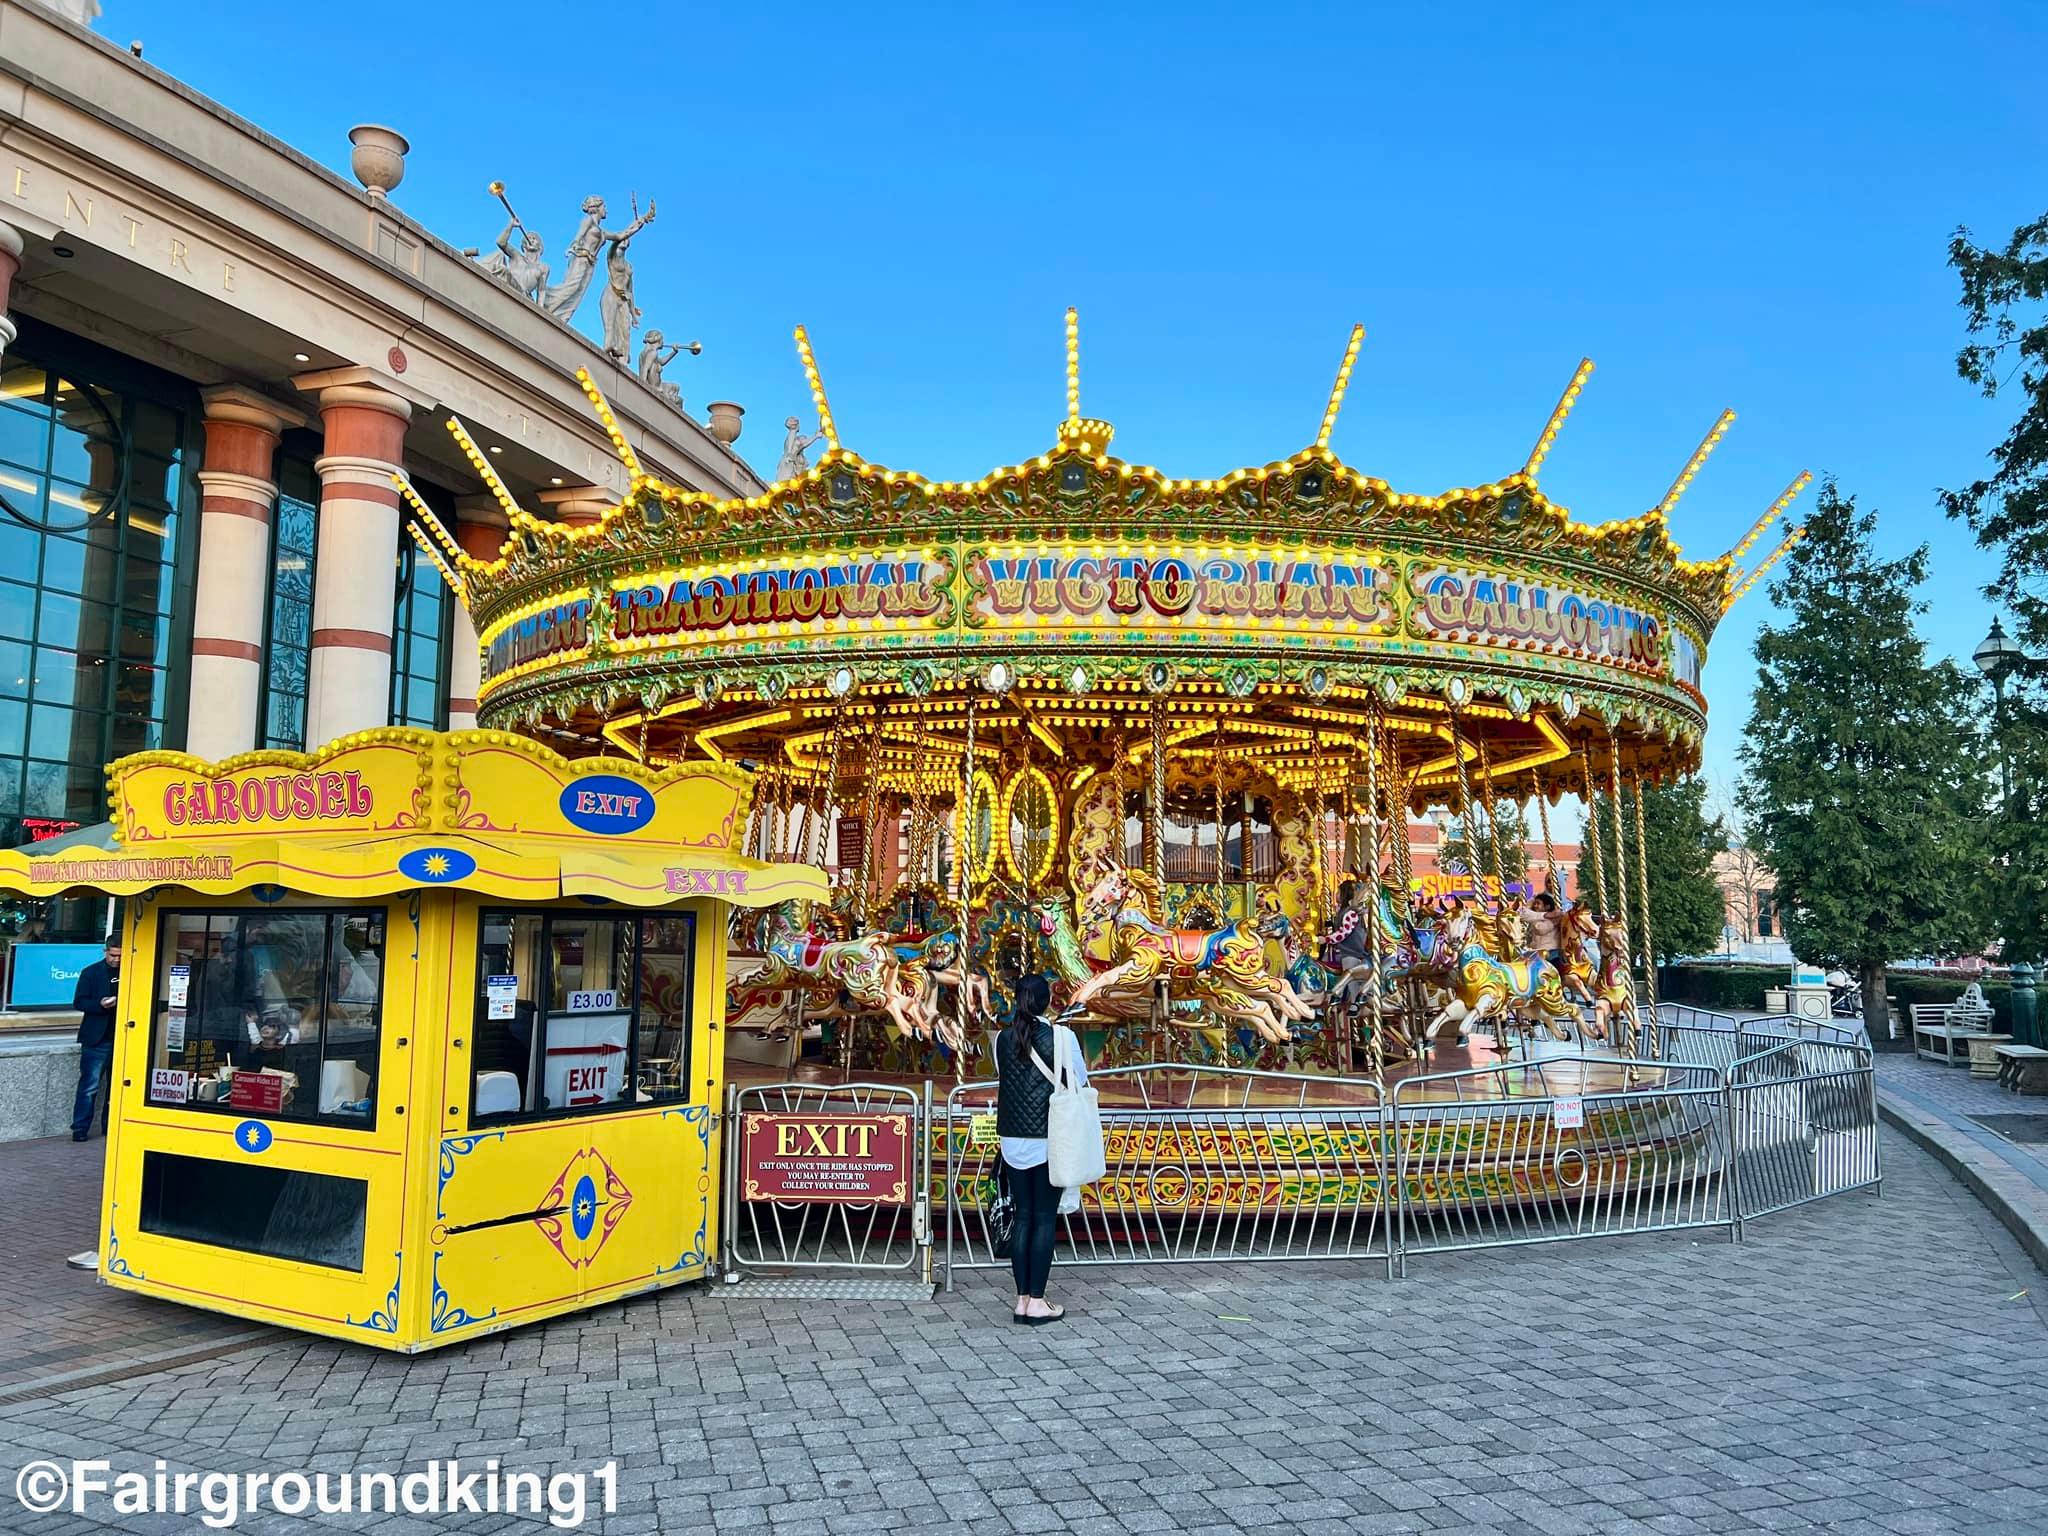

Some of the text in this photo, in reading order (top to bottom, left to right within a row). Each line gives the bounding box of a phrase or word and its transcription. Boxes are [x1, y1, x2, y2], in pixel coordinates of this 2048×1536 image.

[13, 166, 236, 293] ENTRE
[612, 561, 942, 640] TRADITIONAL
[981, 557, 1384, 622] VICTORIAN
[1424, 574, 1660, 666] GALLOPING
[163, 769, 373, 826] CAROUSEL
[575, 790, 643, 818] EXIT
[663, 867, 749, 895] EXIT
[1422, 874, 1501, 898] SWEES
[572, 992, 613, 1009] £3.00
[156, 1071, 183, 1086] £3.00
[568, 1066, 608, 1092] EXIT
[152, 1088, 186, 1099] PER PERSON
[1555, 1102, 1581, 1111] DO NOT
[775, 1123, 878, 1158] EXIT
[759, 1161, 894, 1171] EXIT ONLY ONCE THE RIDE HAS STOPPED
[787, 1172, 802, 1180] YOU
[803, 1172, 819, 1180] MAY
[820, 1172, 853, 1180] RE-ENTER
[781, 1181, 870, 1190] COLLECT YOUR CHILDREN
